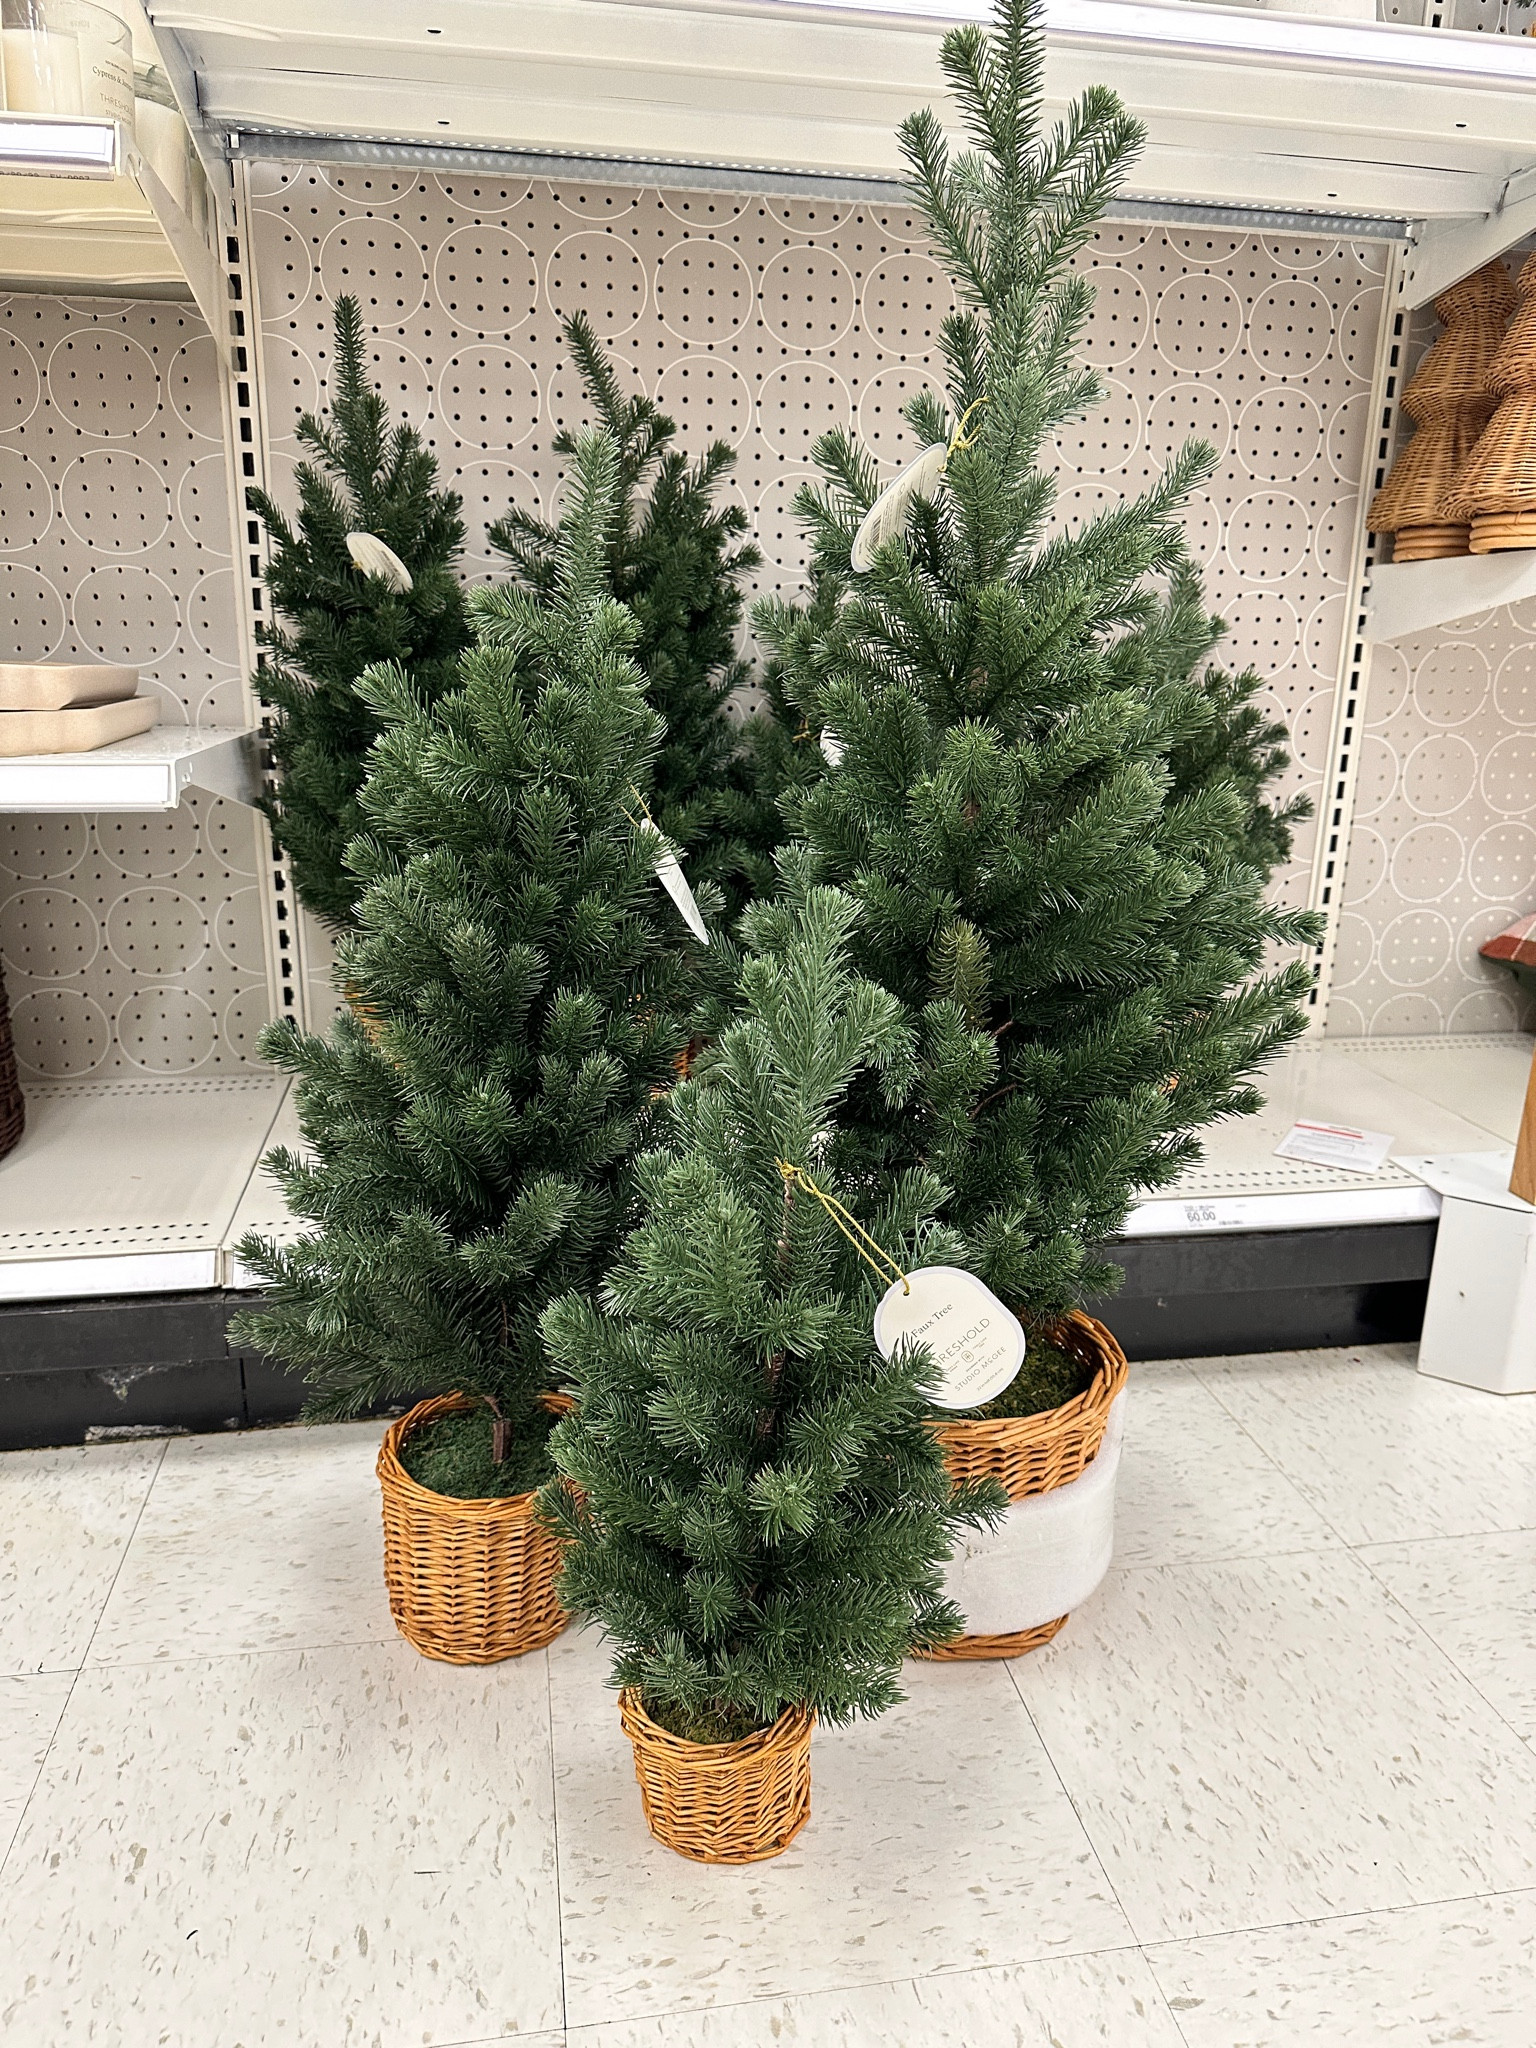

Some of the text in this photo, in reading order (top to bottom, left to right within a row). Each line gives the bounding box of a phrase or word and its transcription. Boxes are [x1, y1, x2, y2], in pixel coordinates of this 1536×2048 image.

[1187, 1211, 1216, 1222] 60.00
[911, 1303, 953, 1338] Faux Tree
[934, 1318, 990, 1367] HRESHOLD
[954, 1367, 981, 1392] STUDIO
